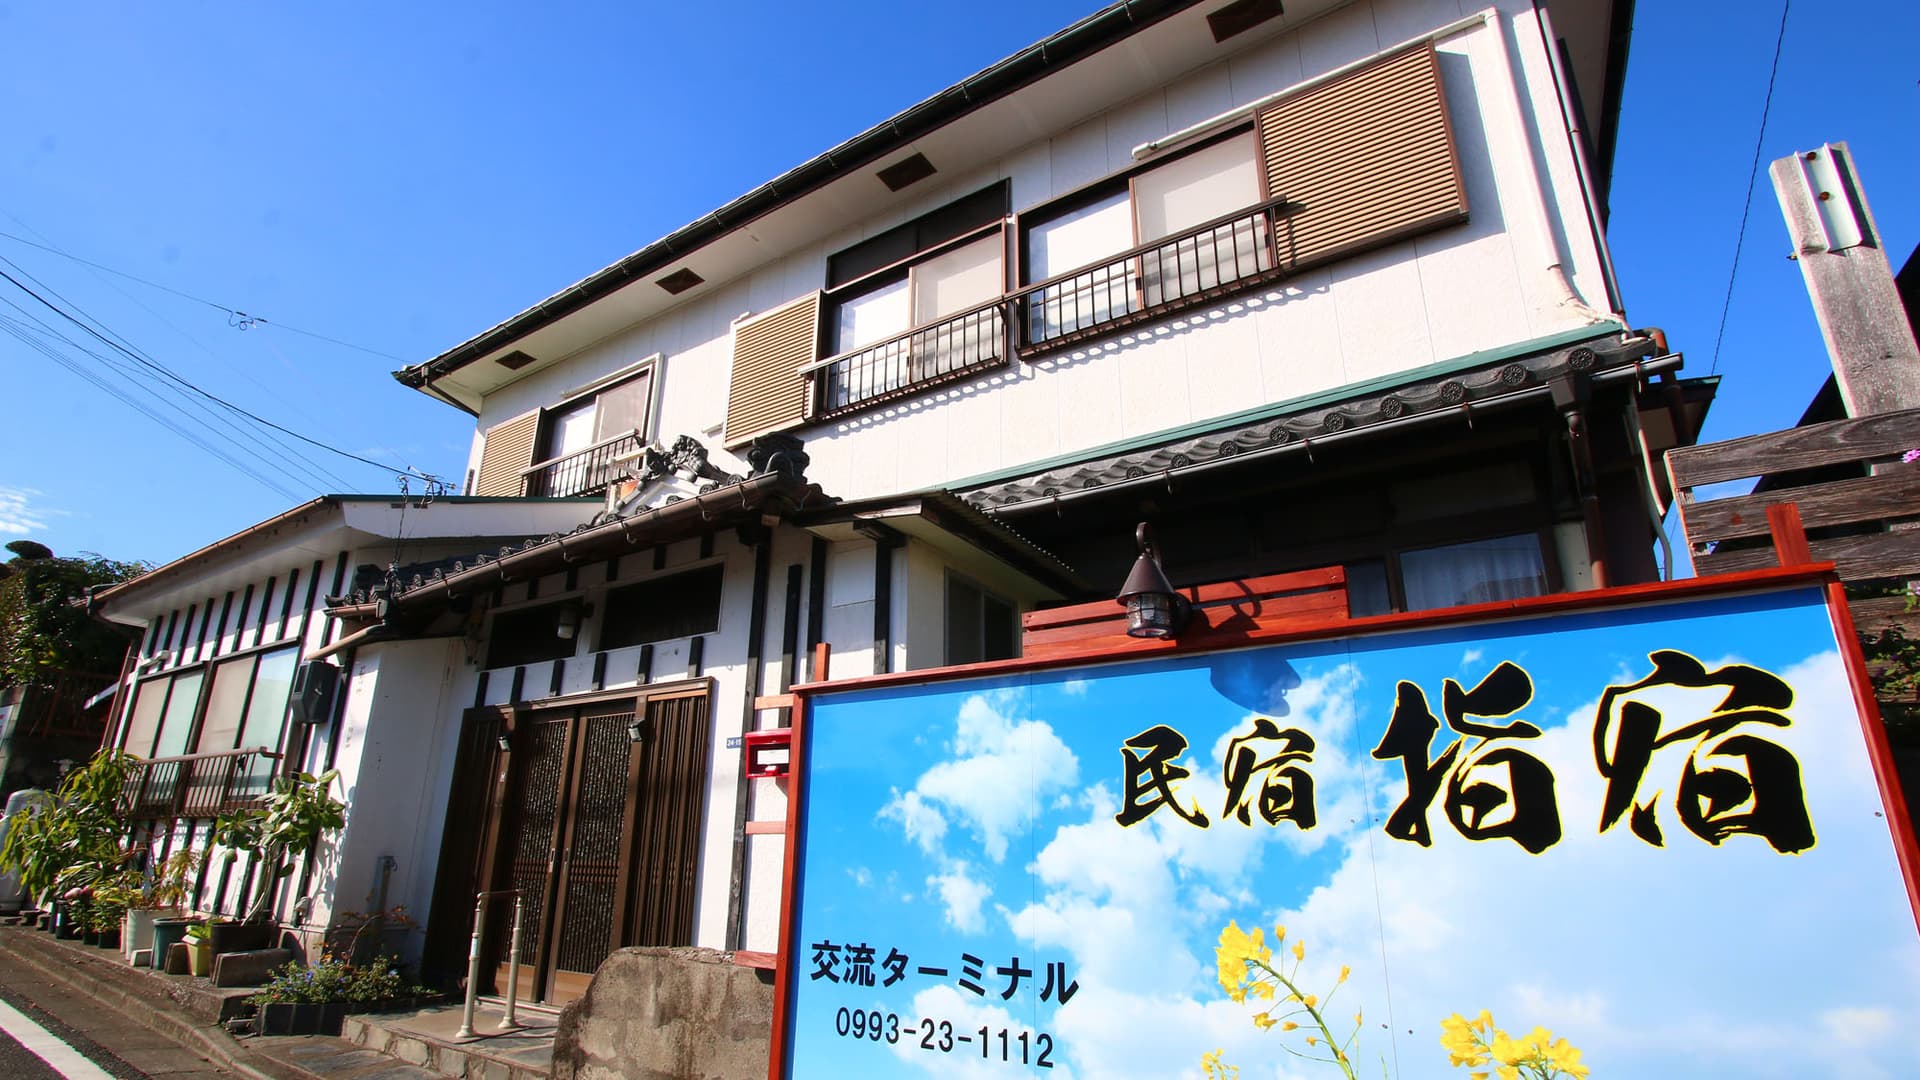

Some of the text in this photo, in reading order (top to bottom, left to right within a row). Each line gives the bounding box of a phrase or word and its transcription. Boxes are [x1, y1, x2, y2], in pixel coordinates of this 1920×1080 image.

[1115, 649, 1818, 855] 民宿 指宿
[811, 940, 1079, 1005] 交流ターミナル
[837, 1007, 1054, 1068] 0993-23-1112
